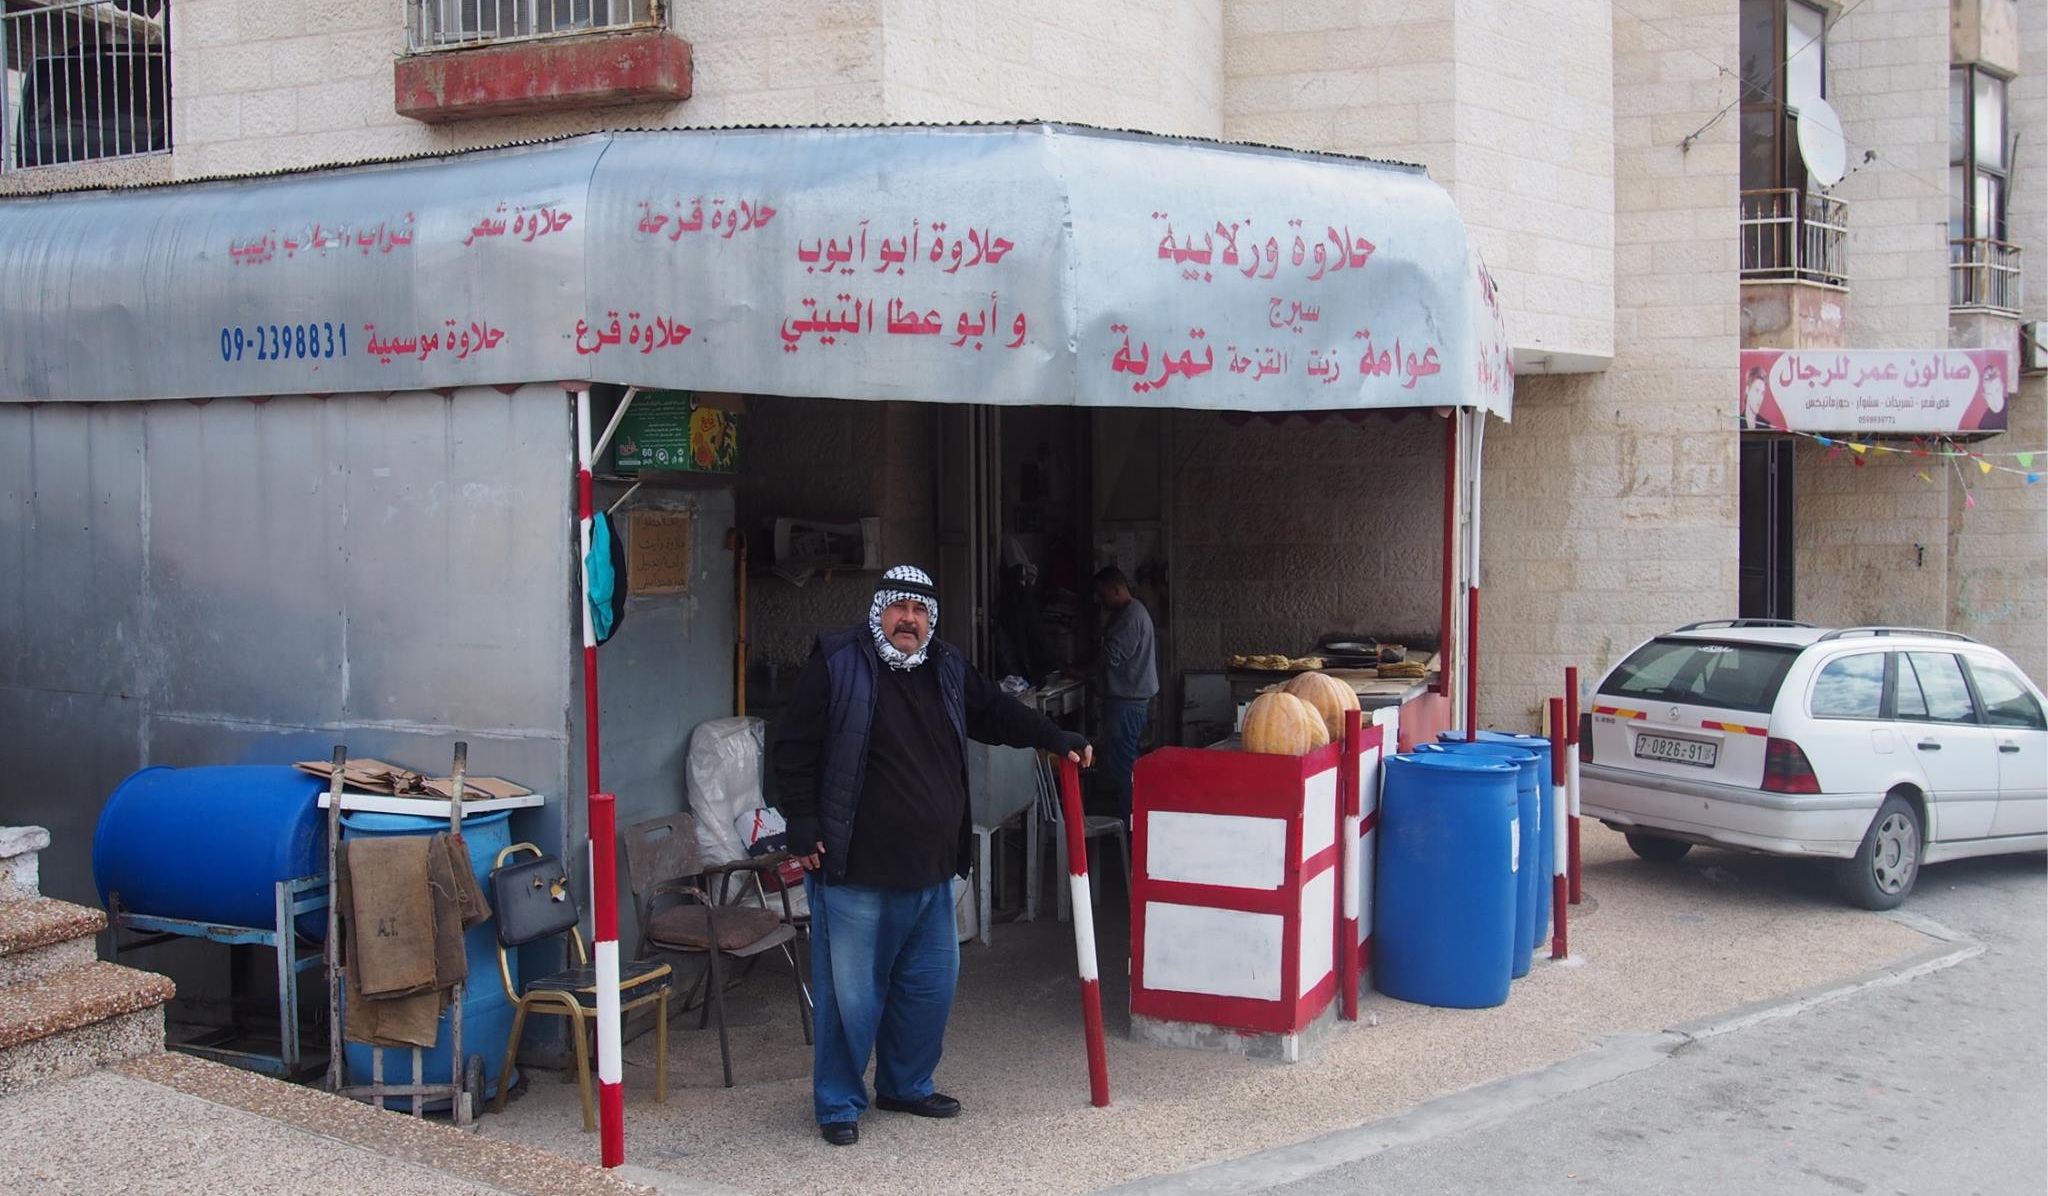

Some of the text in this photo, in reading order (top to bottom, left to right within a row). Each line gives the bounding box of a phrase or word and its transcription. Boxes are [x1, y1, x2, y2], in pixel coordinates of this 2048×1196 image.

[463, 202, 574, 246] حلاوة شعر
[638, 199, 778, 242] حلاوة قزحة
[873, 217, 919, 276] أبو
[929, 222, 1015, 274] حلاوة
[1151, 211, 1376, 283] حلاوة وزلابية
[574, 311, 693, 355] حلاوة قرع
[779, 293, 874, 353] التيتي
[886, 297, 943, 337] عطا
[953, 290, 998, 351] أبو
[1268, 297, 1321, 333] سيرج
[220, 321, 348, 363] 09-2398831
[363, 319, 505, 366] حلاوة موسمية
[1110, 323, 1214, 393] تمرية
[1226, 345, 1341, 384] زيت القزحة
[1353, 329, 1442, 389] عوامة
[1778, 354, 1971, 388] صالون عمر للرجال
